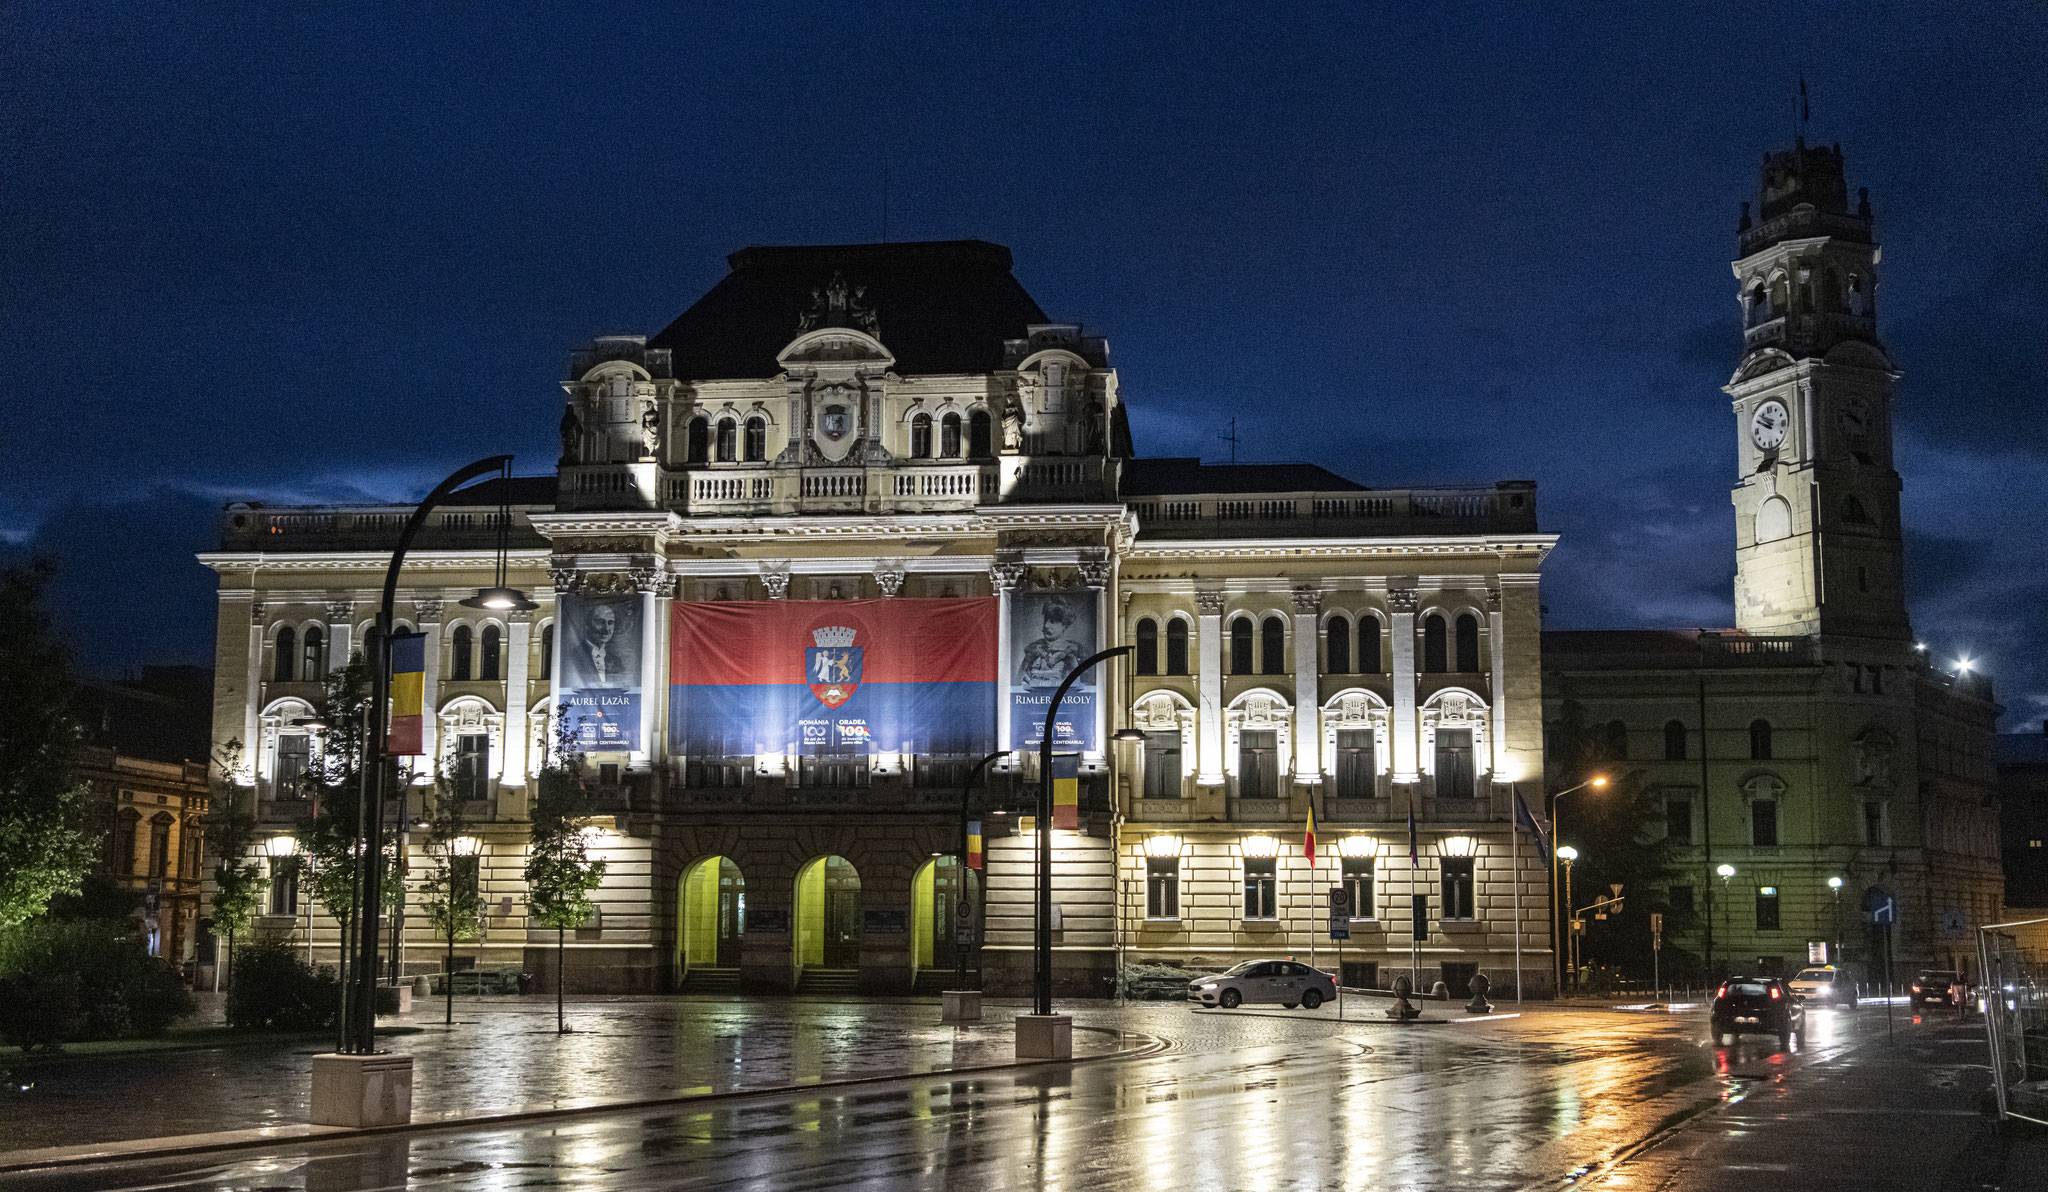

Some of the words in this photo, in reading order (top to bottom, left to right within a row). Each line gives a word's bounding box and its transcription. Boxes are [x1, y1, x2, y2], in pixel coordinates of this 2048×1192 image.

[570, 697, 598, 705] AUREL
[602, 695, 630, 705] LAZĂR
[1016, 695, 1051, 704] RIMLER
[803, 726, 826, 737] 100
[841, 726, 864, 737] 100
[1335, 893, 1344, 902] 20
